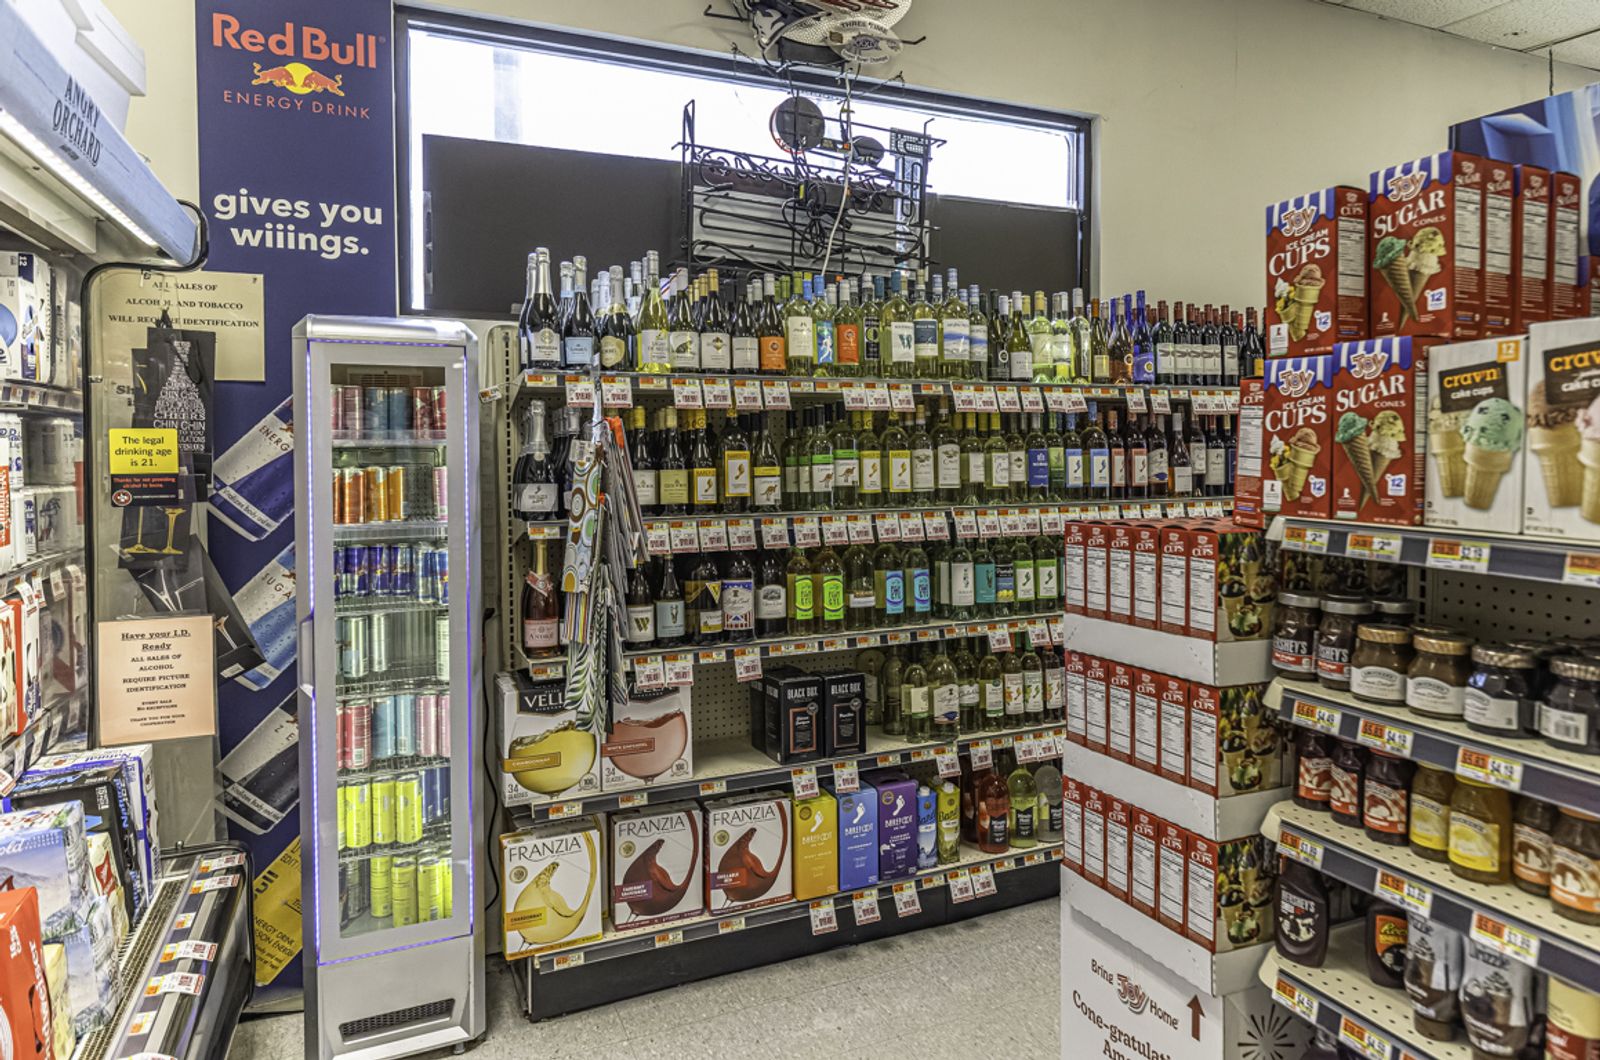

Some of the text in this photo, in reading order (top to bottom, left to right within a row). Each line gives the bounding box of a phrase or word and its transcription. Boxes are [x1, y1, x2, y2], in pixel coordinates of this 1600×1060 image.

[212, 12, 376, 69] Red Bull
[223, 90, 371, 119] ENERGY DRINK
[53, 99, 102, 167] ORCHARD
[213, 188, 383, 228] gives you
[1374, 190, 1445, 239] SUGAR
[1412, 213, 1447, 227] CONES
[230, 223, 370, 260] wiiings.
[1300, 229, 1329, 246] CREAM
[1268, 237, 1331, 276] CUPS
[1429, 292, 1444, 302] 12
[199, 302, 243, 310] TOBACCO
[109, 315, 136, 324] WILL
[183, 318, 259, 327] IDENTIFICATION
[1317, 314, 1330, 326] 12
[1501, 342, 1515, 354] 12
[1561, 379, 1590, 392] cake
[1335, 374, 1406, 412] SUGAR
[1451, 386, 1495, 399] cake cups
[1298, 396, 1326, 408] CREAM
[1374, 400, 1406, 408] CONES
[1264, 405, 1327, 432] CUPS
[122, 436, 164, 445] The legal
[114, 448, 153, 456] drinking
[1312, 481, 1324, 491] 12
[1390, 478, 1404, 487] 12
[121, 632, 146, 640] Have
[149, 632, 171, 640] your
[142, 642, 172, 651] Ready
[127, 683, 186, 693] IDENTIFICATION
[787, 686, 818, 700] BLACK BOX
[831, 682, 861, 695] BLACK BOX
[605, 767, 616, 777] 34
[507, 784, 519, 794] 34
[713, 804, 776, 826] FRANZIA
[618, 814, 686, 837] FRANZIA
[509, 836, 582, 862] FRANZIA
[1091, 959, 1114, 984] Bring
[1150, 1001, 1180, 1030] Home
[1072, 989, 1172, 1060] Cone-gratulat
